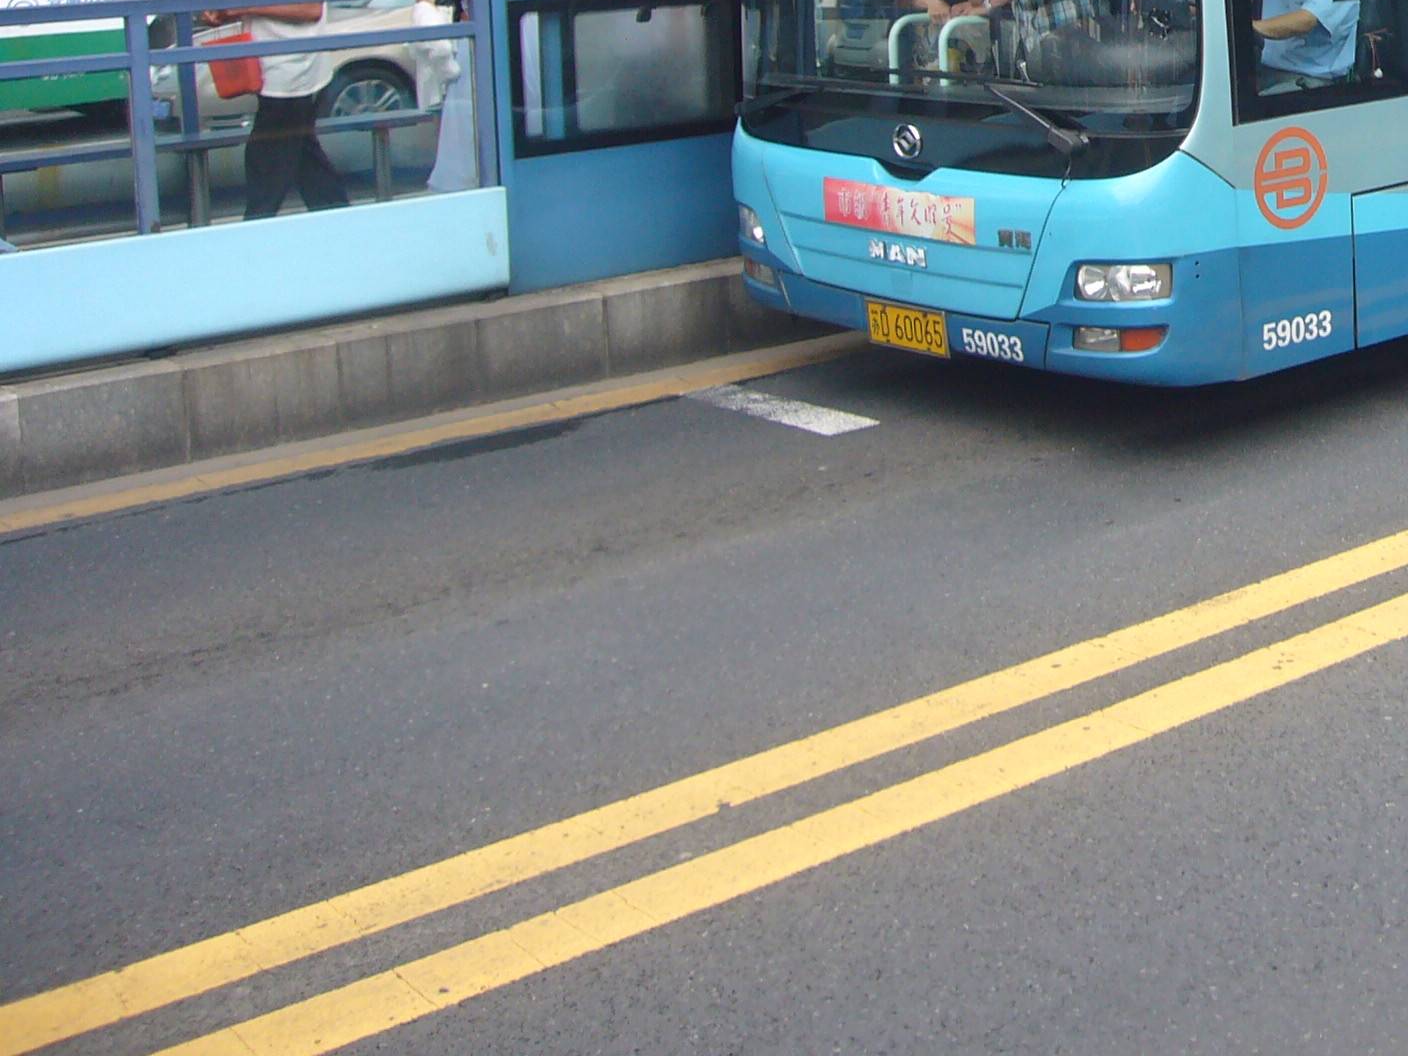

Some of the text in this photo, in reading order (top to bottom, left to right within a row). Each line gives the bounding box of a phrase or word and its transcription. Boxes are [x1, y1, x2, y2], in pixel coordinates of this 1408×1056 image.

[868, 238, 927, 268] MAN
[962, 327, 1025, 363] 59033
[1263, 310, 1332, 351] 59033
